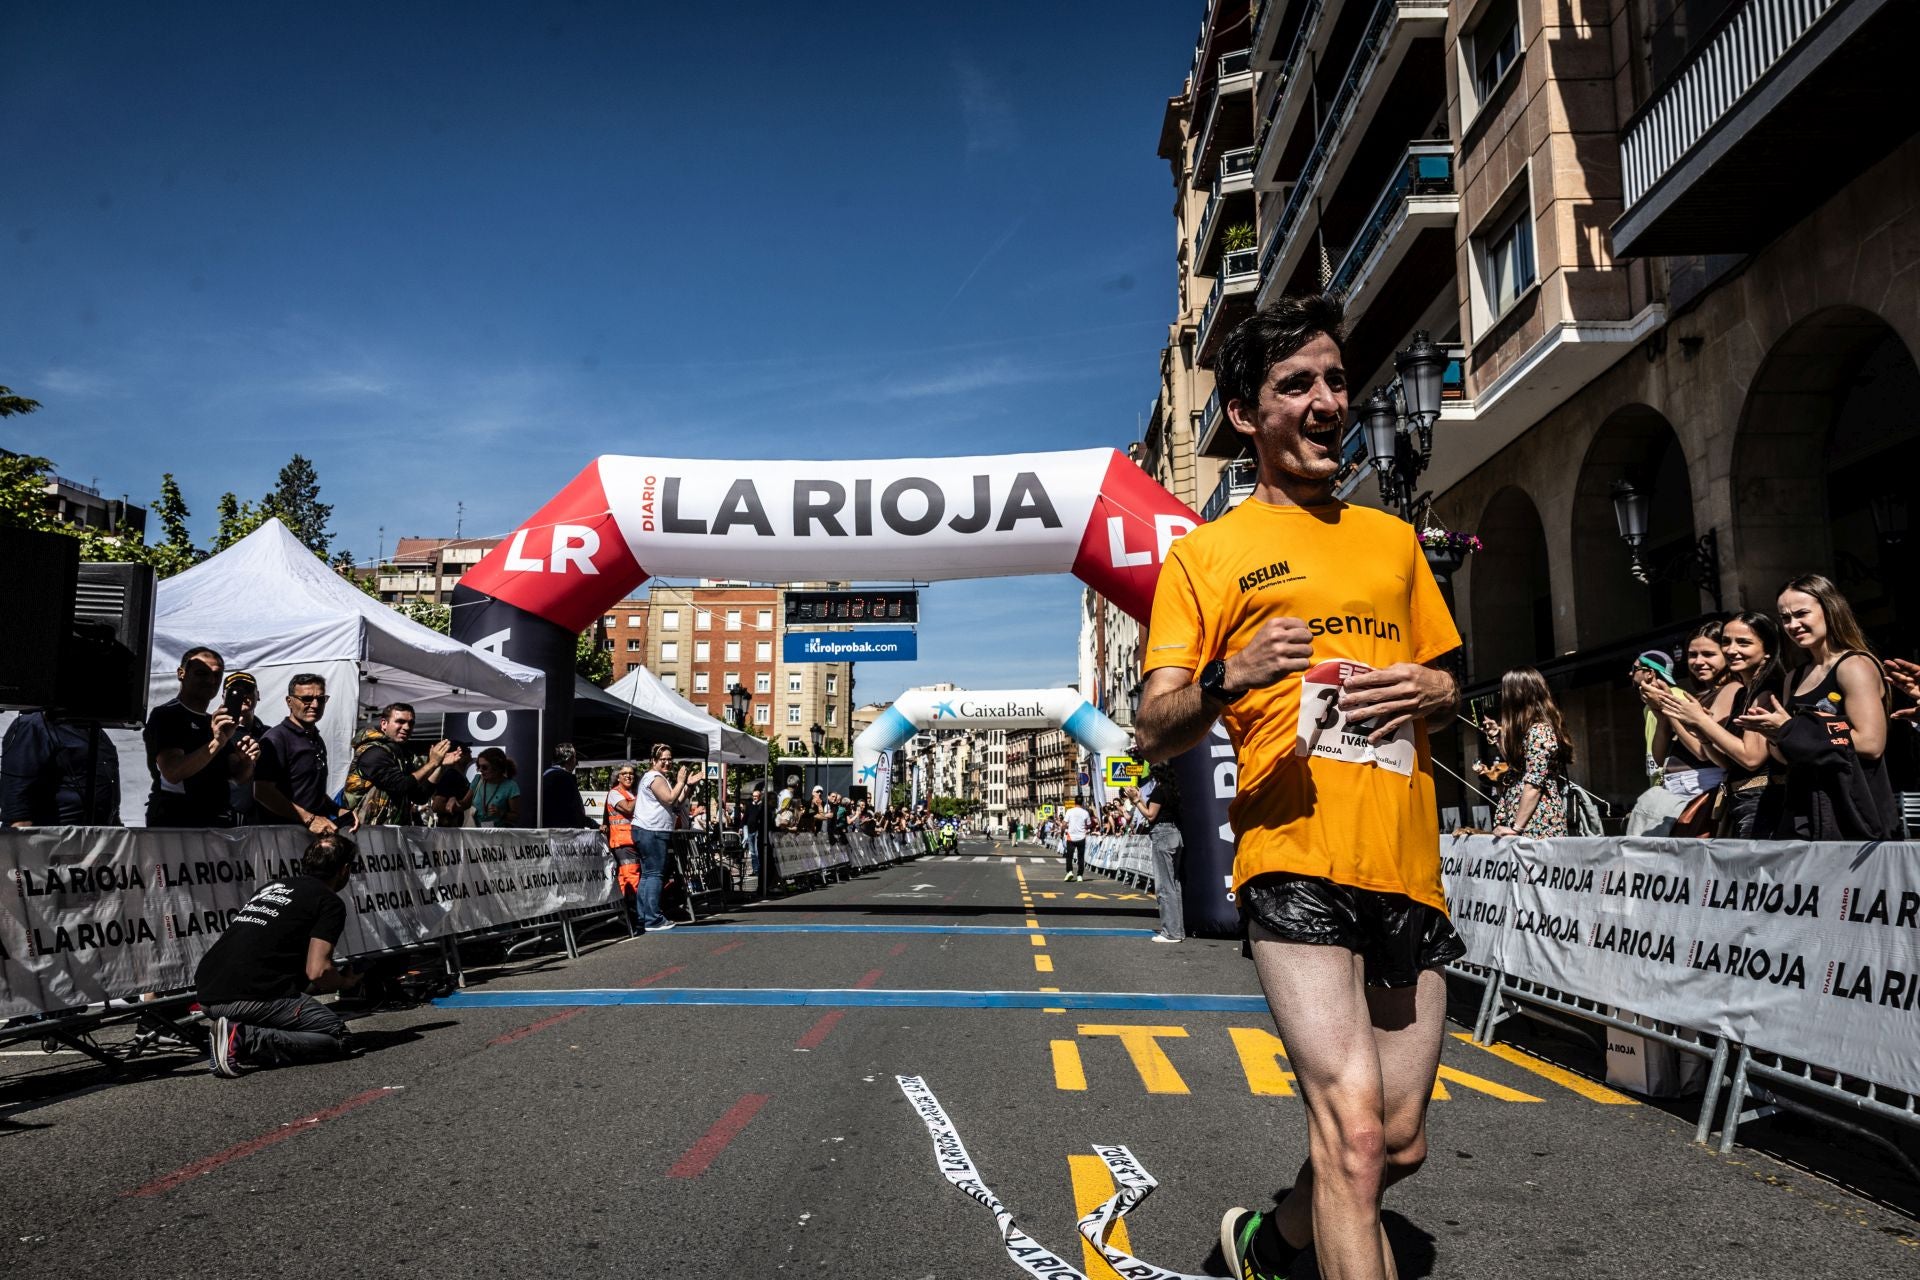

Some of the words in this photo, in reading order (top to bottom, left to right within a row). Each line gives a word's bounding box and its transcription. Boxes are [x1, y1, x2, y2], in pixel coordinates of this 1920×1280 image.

[642, 475, 657, 532] DIARIO
[662, 477, 776, 537] LA
[793, 471, 1063, 538] RIOJA
[503, 524, 600, 576] LR
[1239, 560, 1290, 594] ASELAN
[809, 638, 898, 655] Kirolprobak.com
[960, 701, 1046, 718] CaixaBank
[1317, 745, 1342, 755] RIOJA
[163, 863, 194, 887] LA
[195, 860, 256, 884] RIOJA
[366, 853, 406, 873] RIOJA
[1549, 867, 1593, 893] RIOJA
[23, 868, 67, 896] LA
[68, 865, 146, 893] RIOJA
[1605, 871, 1626, 897] LA
[1630, 873, 1690, 905] RIOJA
[1701, 880, 1711, 906] DIARIO
[375, 890, 413, 911] RIOJA
[1708, 880, 1738, 910] LA
[1742, 882, 1819, 917] RIOJA
[1840, 887, 1849, 921] DIARIO
[1848, 888, 1889, 925] LA
[34, 928, 75, 955] LA
[78, 918, 156, 950] RIOJA
[172, 913, 204, 938] LA
[1516, 909, 1534, 934] LA
[1535, 914, 1578, 944] RIOJA
[1594, 923, 1616, 951] LA
[1618, 928, 1675, 964] RIOJA
[1692, 941, 1721, 973] LA
[1724, 945, 1806, 990] RIOJA
[1823, 961, 1835, 994] DIARIO
[1832, 962, 1873, 1004] LA
